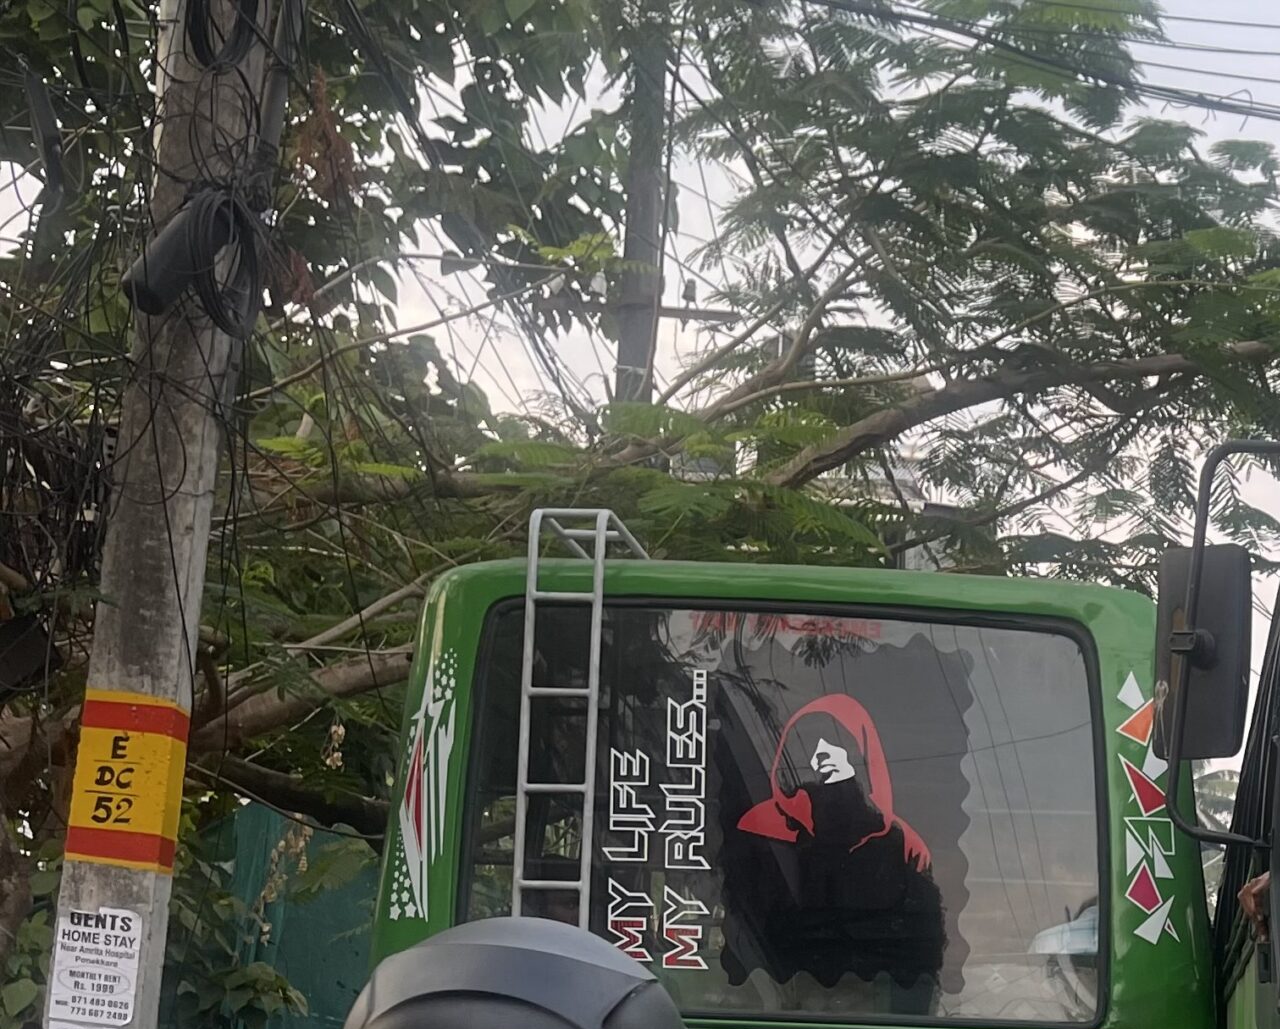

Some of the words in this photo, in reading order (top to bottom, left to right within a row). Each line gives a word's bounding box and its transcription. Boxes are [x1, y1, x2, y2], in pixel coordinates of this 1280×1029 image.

[111, 735, 130, 760] E
[95, 765, 135, 789] DC
[91, 796, 133, 824] 52
[602, 748, 656, 861] LIFE
[62, 928, 100, 945] HOME
[104, 933, 137, 949] STAY
[662, 885, 710, 970] MY
[60, 942, 78, 952] Near
